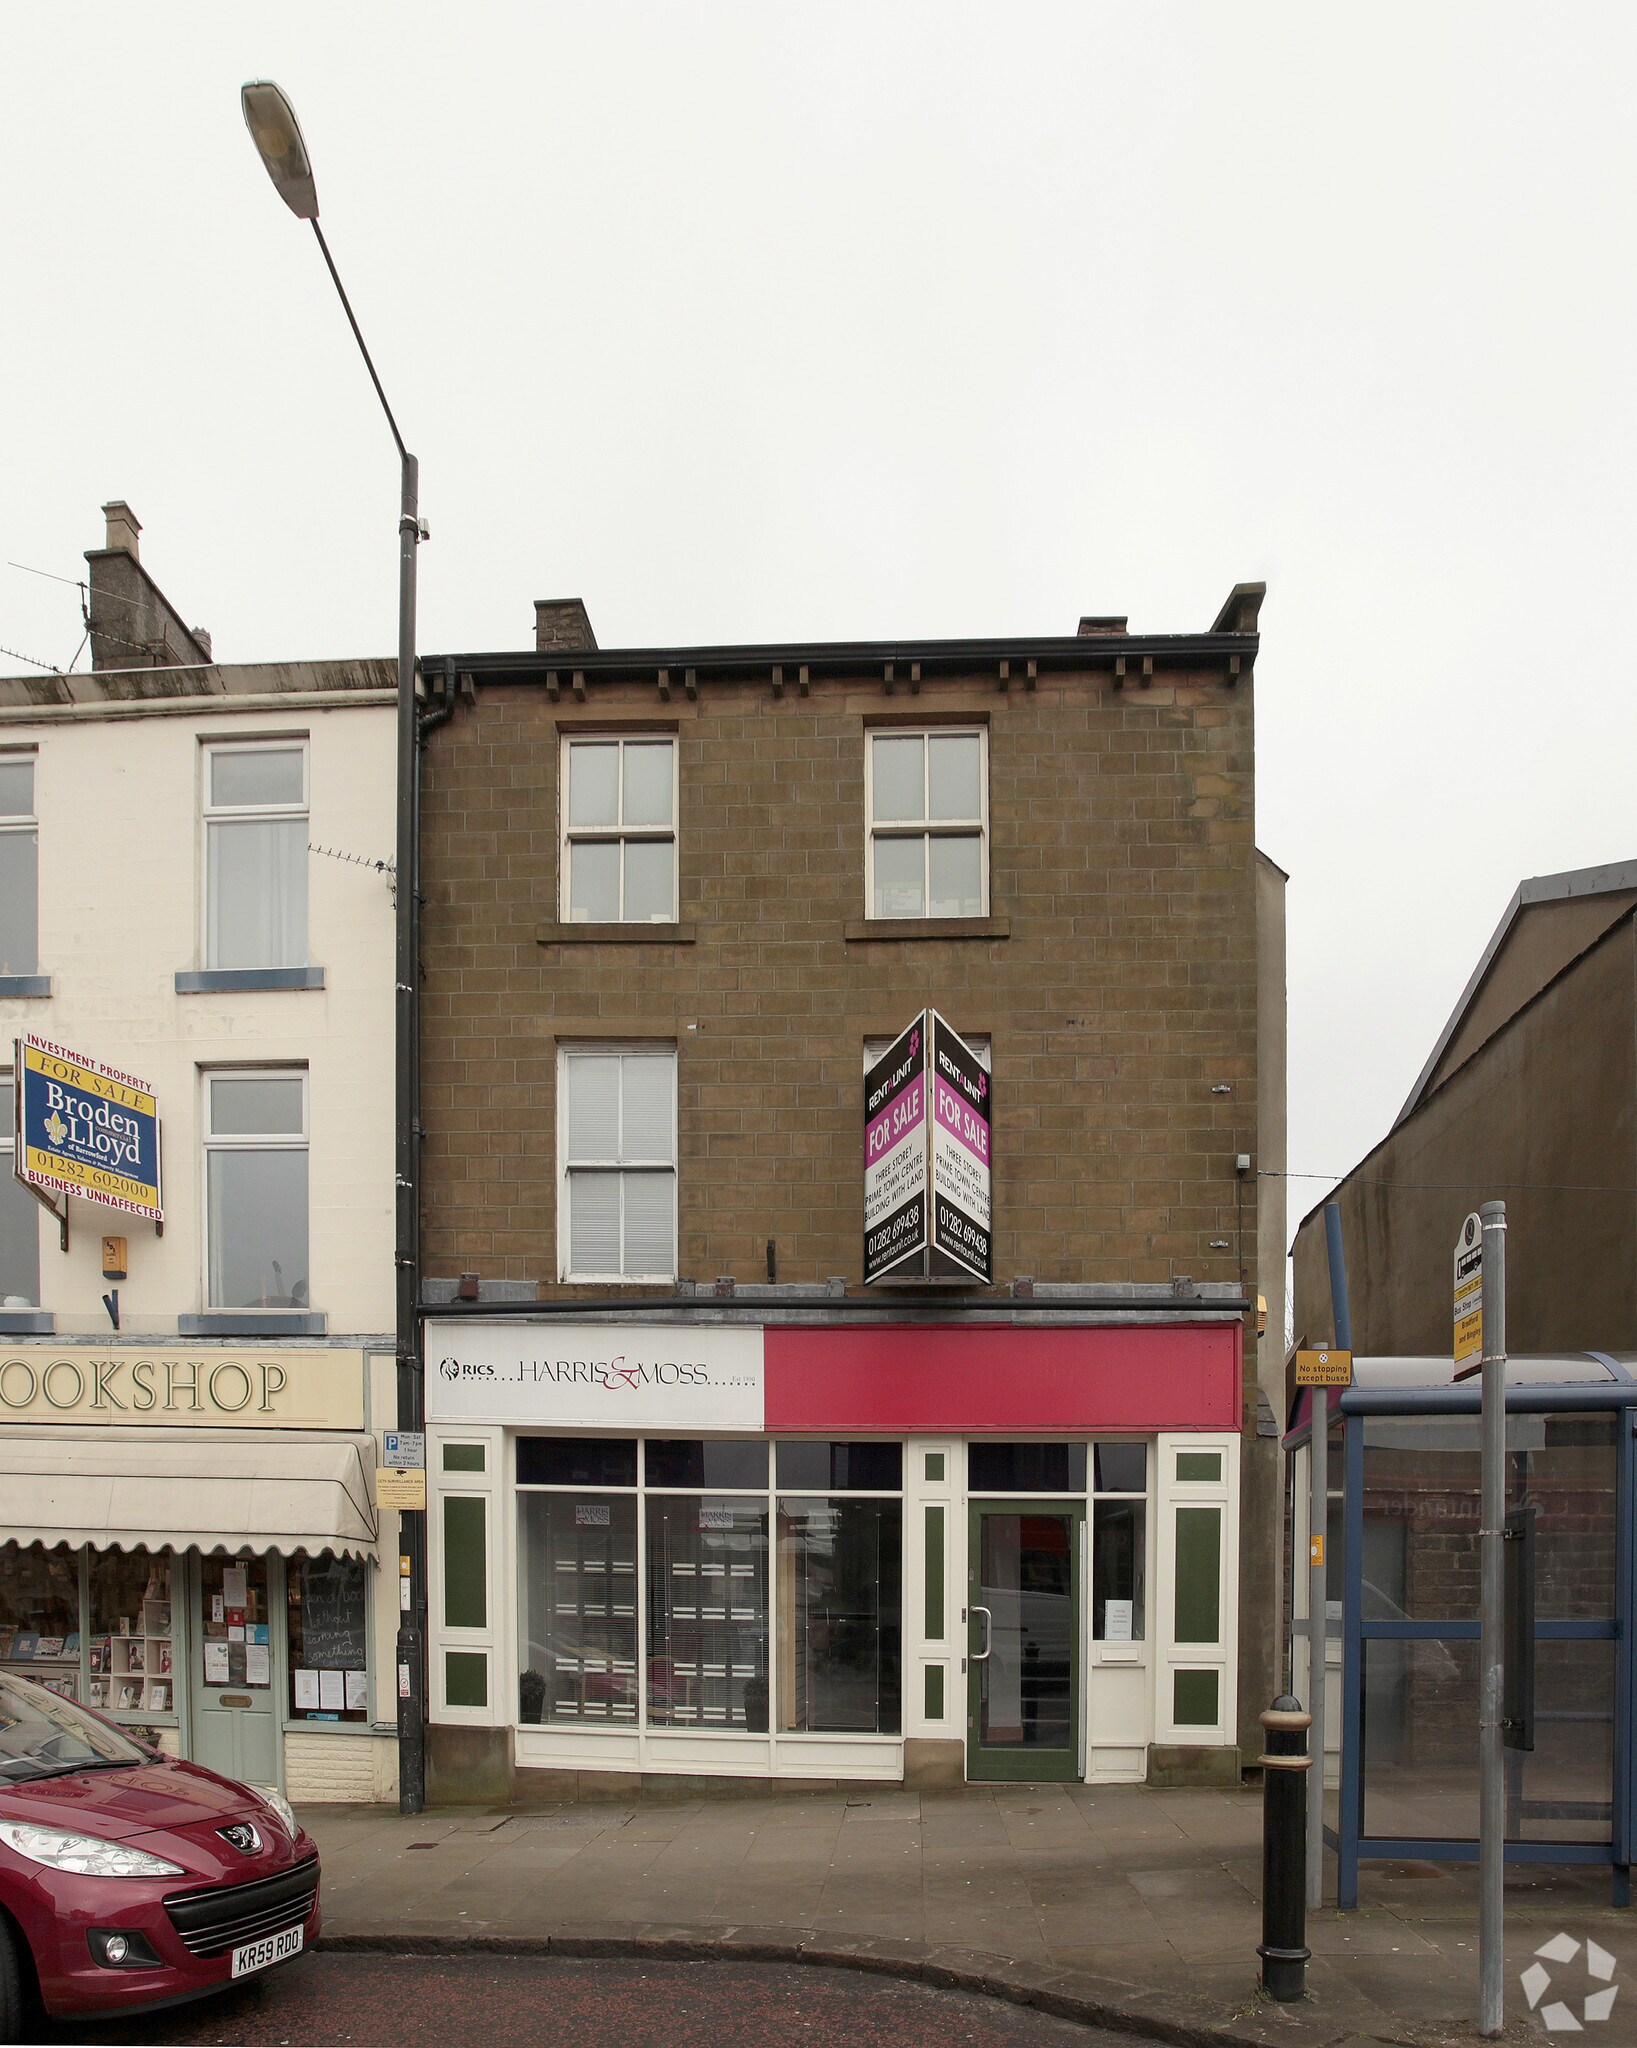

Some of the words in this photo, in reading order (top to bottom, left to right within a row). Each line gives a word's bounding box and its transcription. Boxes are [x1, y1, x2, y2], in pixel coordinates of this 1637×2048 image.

[27, 1033, 96, 1070] INVESTMENT
[100, 1063, 152, 1093] PROPERTY
[40, 1056, 82, 1085] FOR
[92, 1078, 145, 1110] SALE
[46, 1081, 141, 1141] Broden
[869, 1118, 891, 1157] FOR
[893, 1088, 919, 1135] SALE
[939, 1087, 961, 1132] FOR
[964, 1112, 987, 1156] SALE
[67, 1115, 141, 1166] Lloyd
[67, 1143, 77, 1152] of
[76, 1145, 108, 1162] Barrowford
[37, 1151, 85, 1179] 01282
[93, 1171, 149, 1199] 602000
[864, 1186, 882, 1207] PRIME
[883, 1171, 900, 1193] TOWN
[901, 1151, 923, 1178] CENTRE
[875, 1163, 891, 1185] THREE
[892, 1143, 913, 1171] STOREY
[935, 1152, 953, 1175] PRIME
[954, 1167, 971, 1190] TOWN
[971, 1183, 991, 1207] CENTRE
[946, 1143, 962, 1167] THREE
[963, 1159, 982, 1184] STOREY
[28, 1170, 82, 1196] BUSINESS
[87, 1189, 162, 1220] UNNAFFECTED
[864, 1196, 891, 1222] BUILDING
[891, 1182, 906, 1203] WITH
[907, 1168, 924, 1190] LAND
[935, 1169, 961, 1198] BUILDING
[962, 1190, 976, 1210] WITH
[976, 1200, 991, 1222] LAND
[868, 1226, 891, 1256] 01282
[892, 1204, 920, 1240] 699438
[868, 1227, 919, 1270] www.rentaunit.co.uk
[940, 1205, 963, 1238] 01282
[963, 1224, 988, 1256] 699438
[1454, 1304, 1462, 1317] Bus
[1462, 1298, 1472, 1312] Stop
[1461, 1313, 1479, 1330] Bradford
[1458, 1331, 1466, 1344] and
[1467, 1327, 1481, 1340] Bingley
[462, 1363, 495, 1376] RICS
[519, 1360, 608, 1384] HARRIS
[602, 1355, 640, 1391] &
[637, 1361, 709, 1386] MOSS
[1297, 1374, 1323, 1383] except
[1325, 1374, 1350, 1382] buses
[1300, 1365, 1311, 1373] No
[1313, 1365, 1348, 1374] stopping
[577, 1505, 609, 1516] HARRIS
[584, 1514, 609, 1524] MOSS
[701, 1509, 732, 1519] HARRIS
[239, 1940, 274, 1972] KR59
[277, 1930, 299, 1957] RDO
